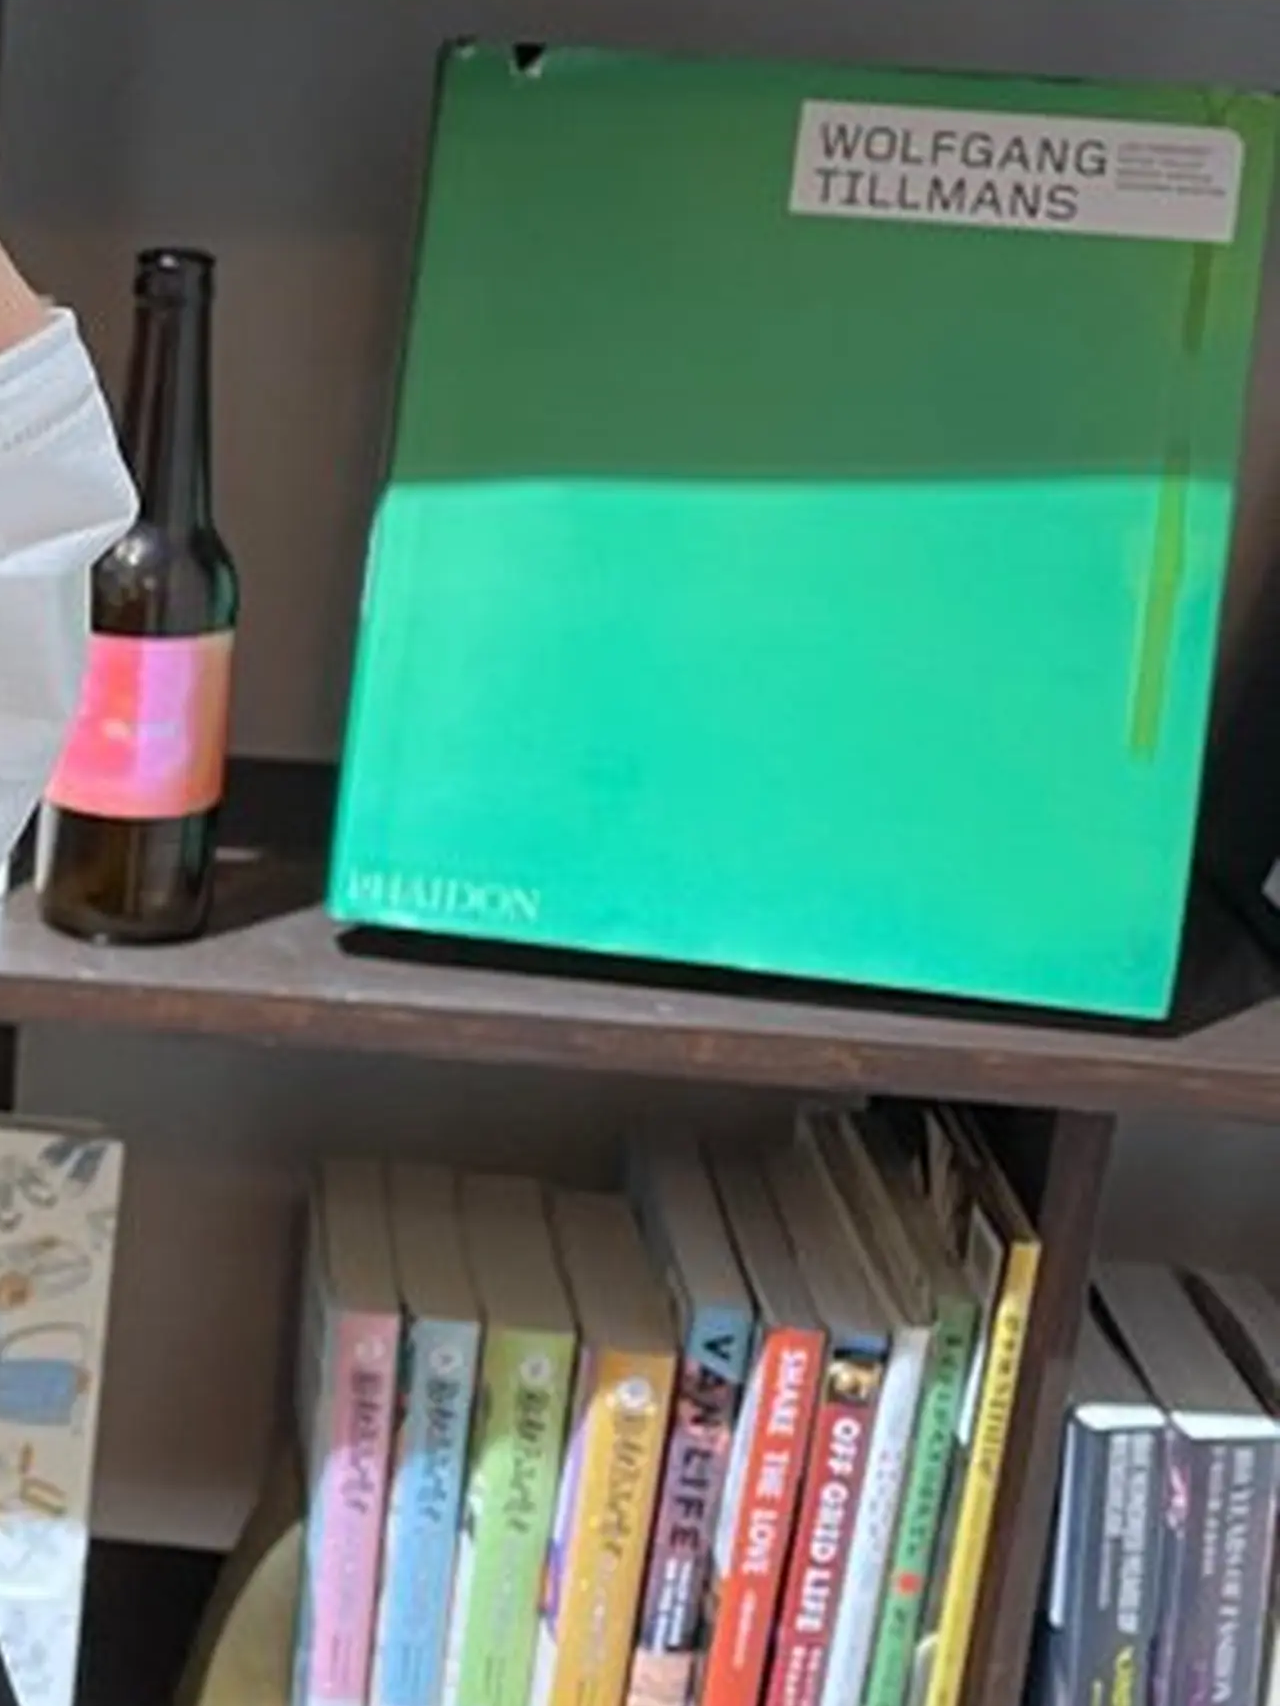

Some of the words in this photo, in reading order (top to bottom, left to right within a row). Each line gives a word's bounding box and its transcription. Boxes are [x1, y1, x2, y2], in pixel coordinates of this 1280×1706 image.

[819, 122, 1108, 177] WOLFGANG
[815, 167, 1080, 222] TILLMANS
[347, 866, 541, 923] PHAIDON
[682, 1331, 738, 1430] VAN
[766, 1347, 810, 1440] SHARE
[830, 1417, 863, 1465] OFF
[667, 1444, 719, 1555] LIFE
[755, 1449, 792, 1503] THE
[742, 1507, 781, 1578] LOVE
[810, 1471, 854, 1565] GRID
[794, 1565, 835, 1634] LIFE
